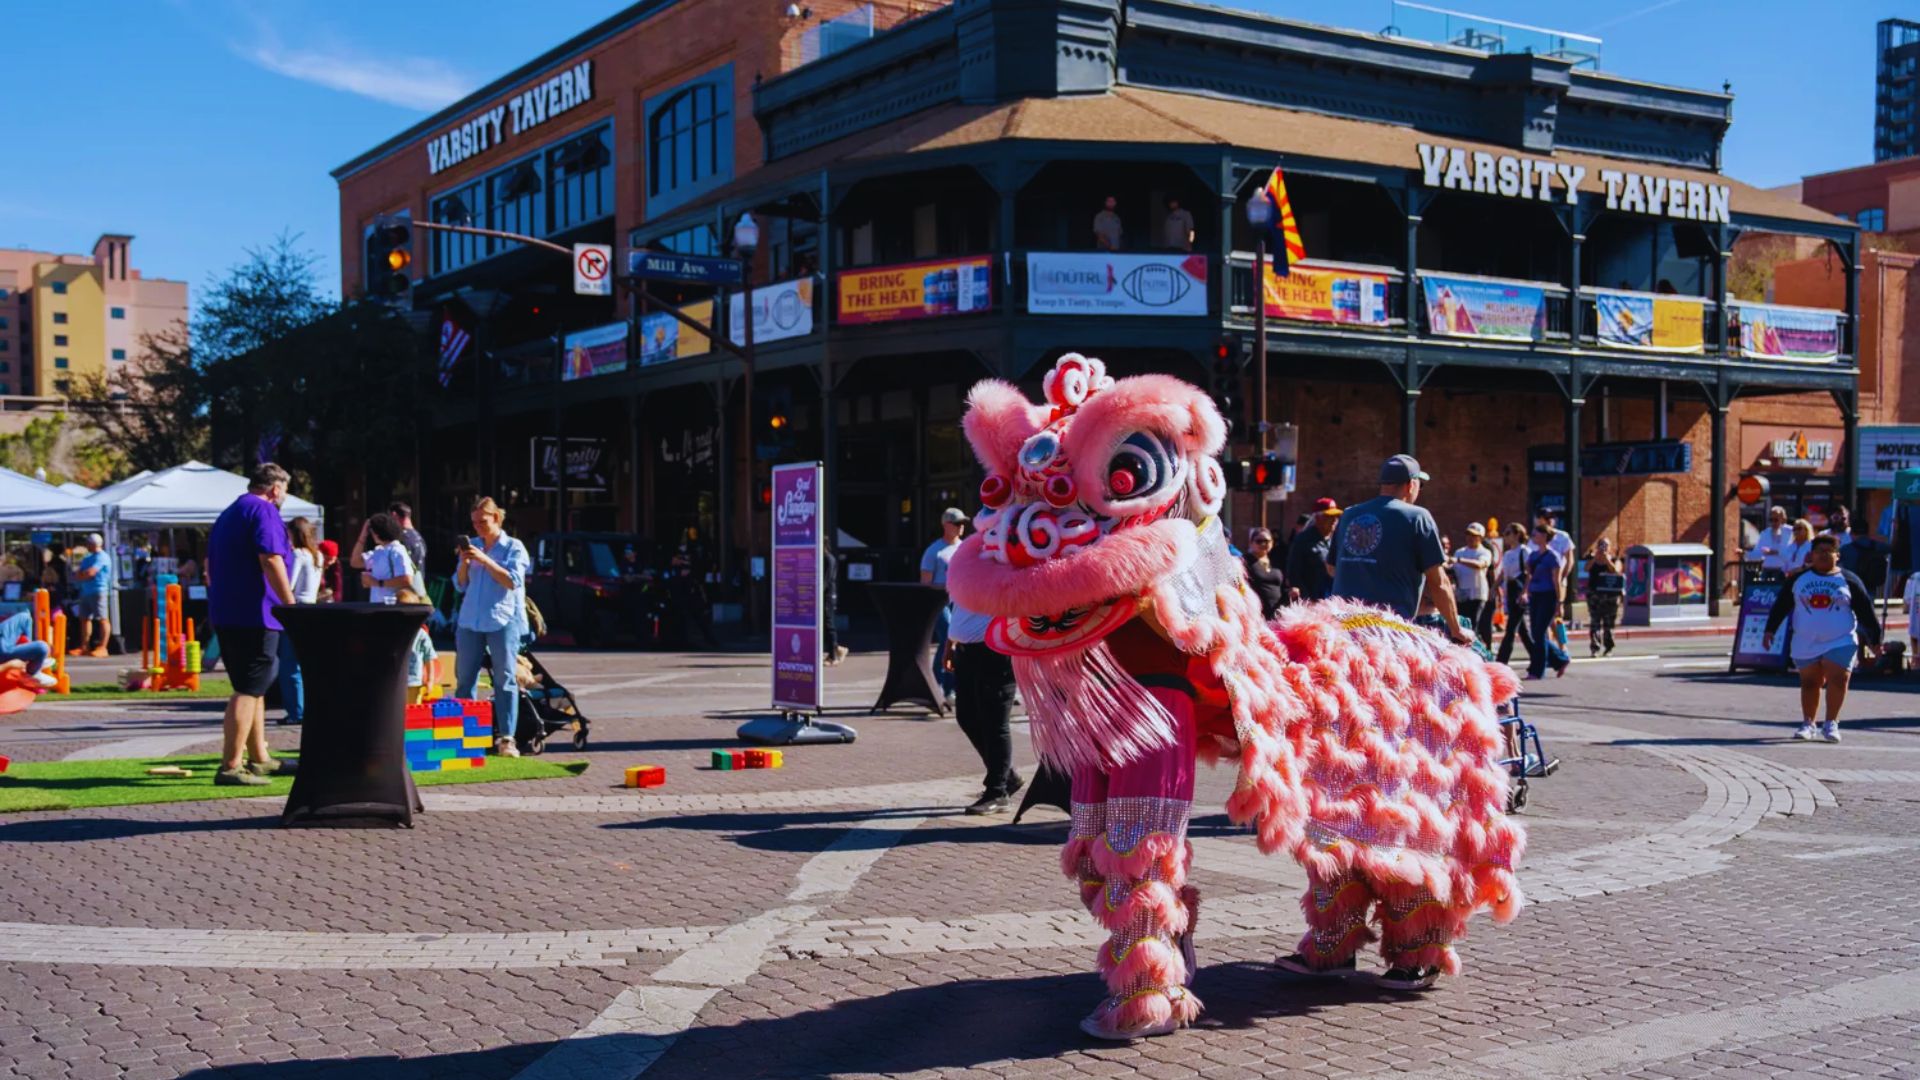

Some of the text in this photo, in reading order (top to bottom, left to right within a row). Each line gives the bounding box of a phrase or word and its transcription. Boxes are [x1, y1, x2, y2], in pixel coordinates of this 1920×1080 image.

[427, 60, 592, 175] VARSITY TAVERN
[1418, 143, 1730, 224] VARSITY TAVERN
[646, 258, 676, 273] Mill
[681, 260, 709, 275] Ave.
[859, 272, 905, 291] BRING
[845, 288, 918, 308] THE HEAT
[1292, 287, 1327, 304] HEAT
[1876, 444, 1920, 456] MOVIES
[777, 661, 814, 673] DOWNTOWN
